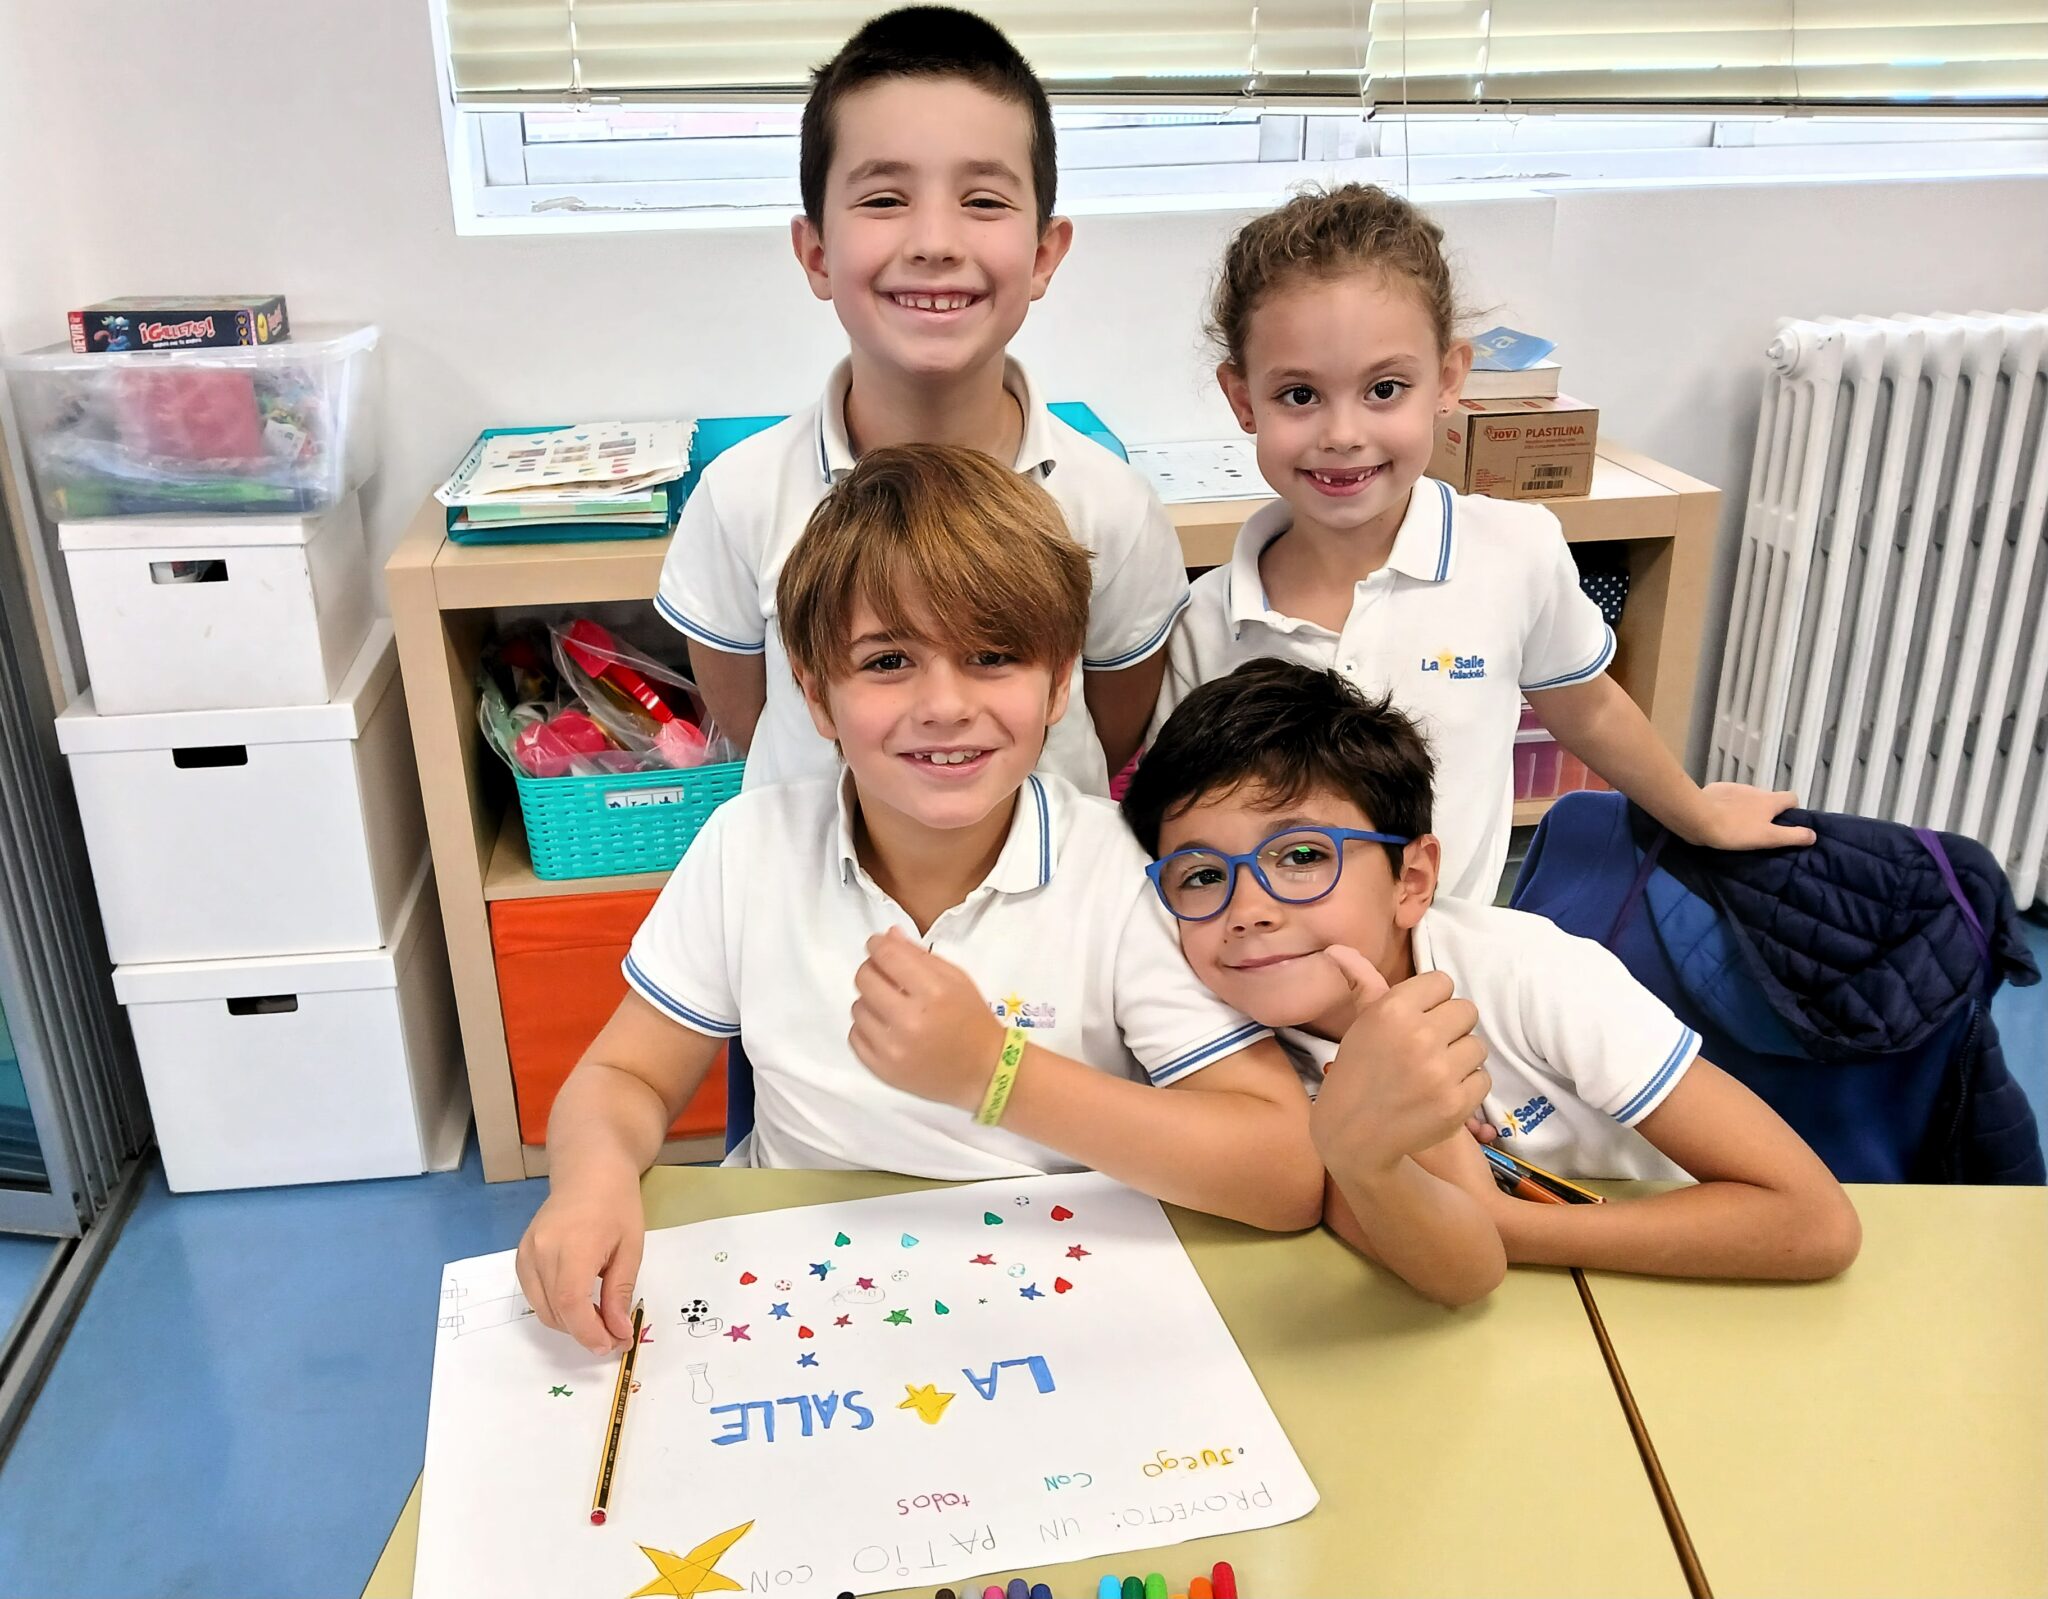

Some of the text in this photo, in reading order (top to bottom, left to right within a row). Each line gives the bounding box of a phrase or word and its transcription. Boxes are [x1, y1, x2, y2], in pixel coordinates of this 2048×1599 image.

[70, 323, 87, 353] DEVIR
[1491, 425, 1585, 440] JOVI PLASTILINA
[1421, 655, 1485, 672] La Salle
[1513, 1095, 1548, 1122] Salle
[709, 1355, 1056, 1446] LA SALLE
